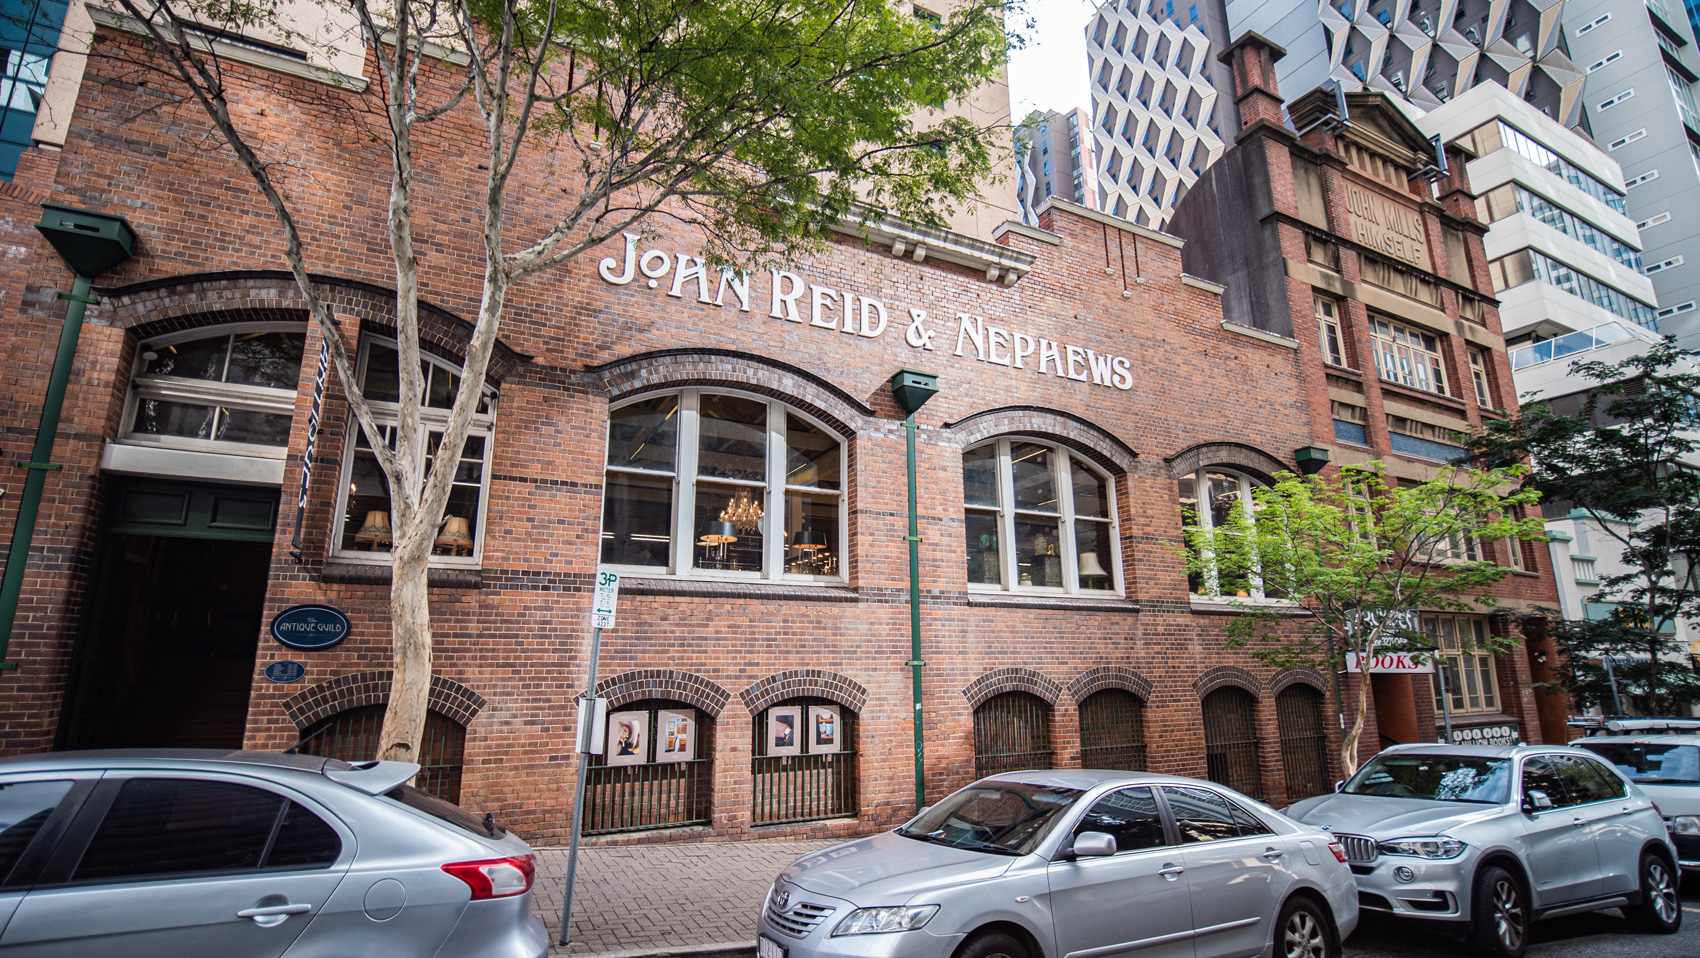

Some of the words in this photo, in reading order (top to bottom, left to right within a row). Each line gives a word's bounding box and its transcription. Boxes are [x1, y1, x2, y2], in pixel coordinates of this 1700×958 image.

[1345, 184, 1380, 226] JOHN
[1382, 201, 1424, 244] MILLS
[1354, 220, 1421, 265] HIMSELF
[768, 267, 888, 338] REID
[905, 308, 935, 351] &
[953, 312, 1134, 391] NEPHEWS
[599, 572, 617, 586] 3P
[280, 622, 316, 632] ANTIQUE
[317, 623, 342, 632] GUILD
